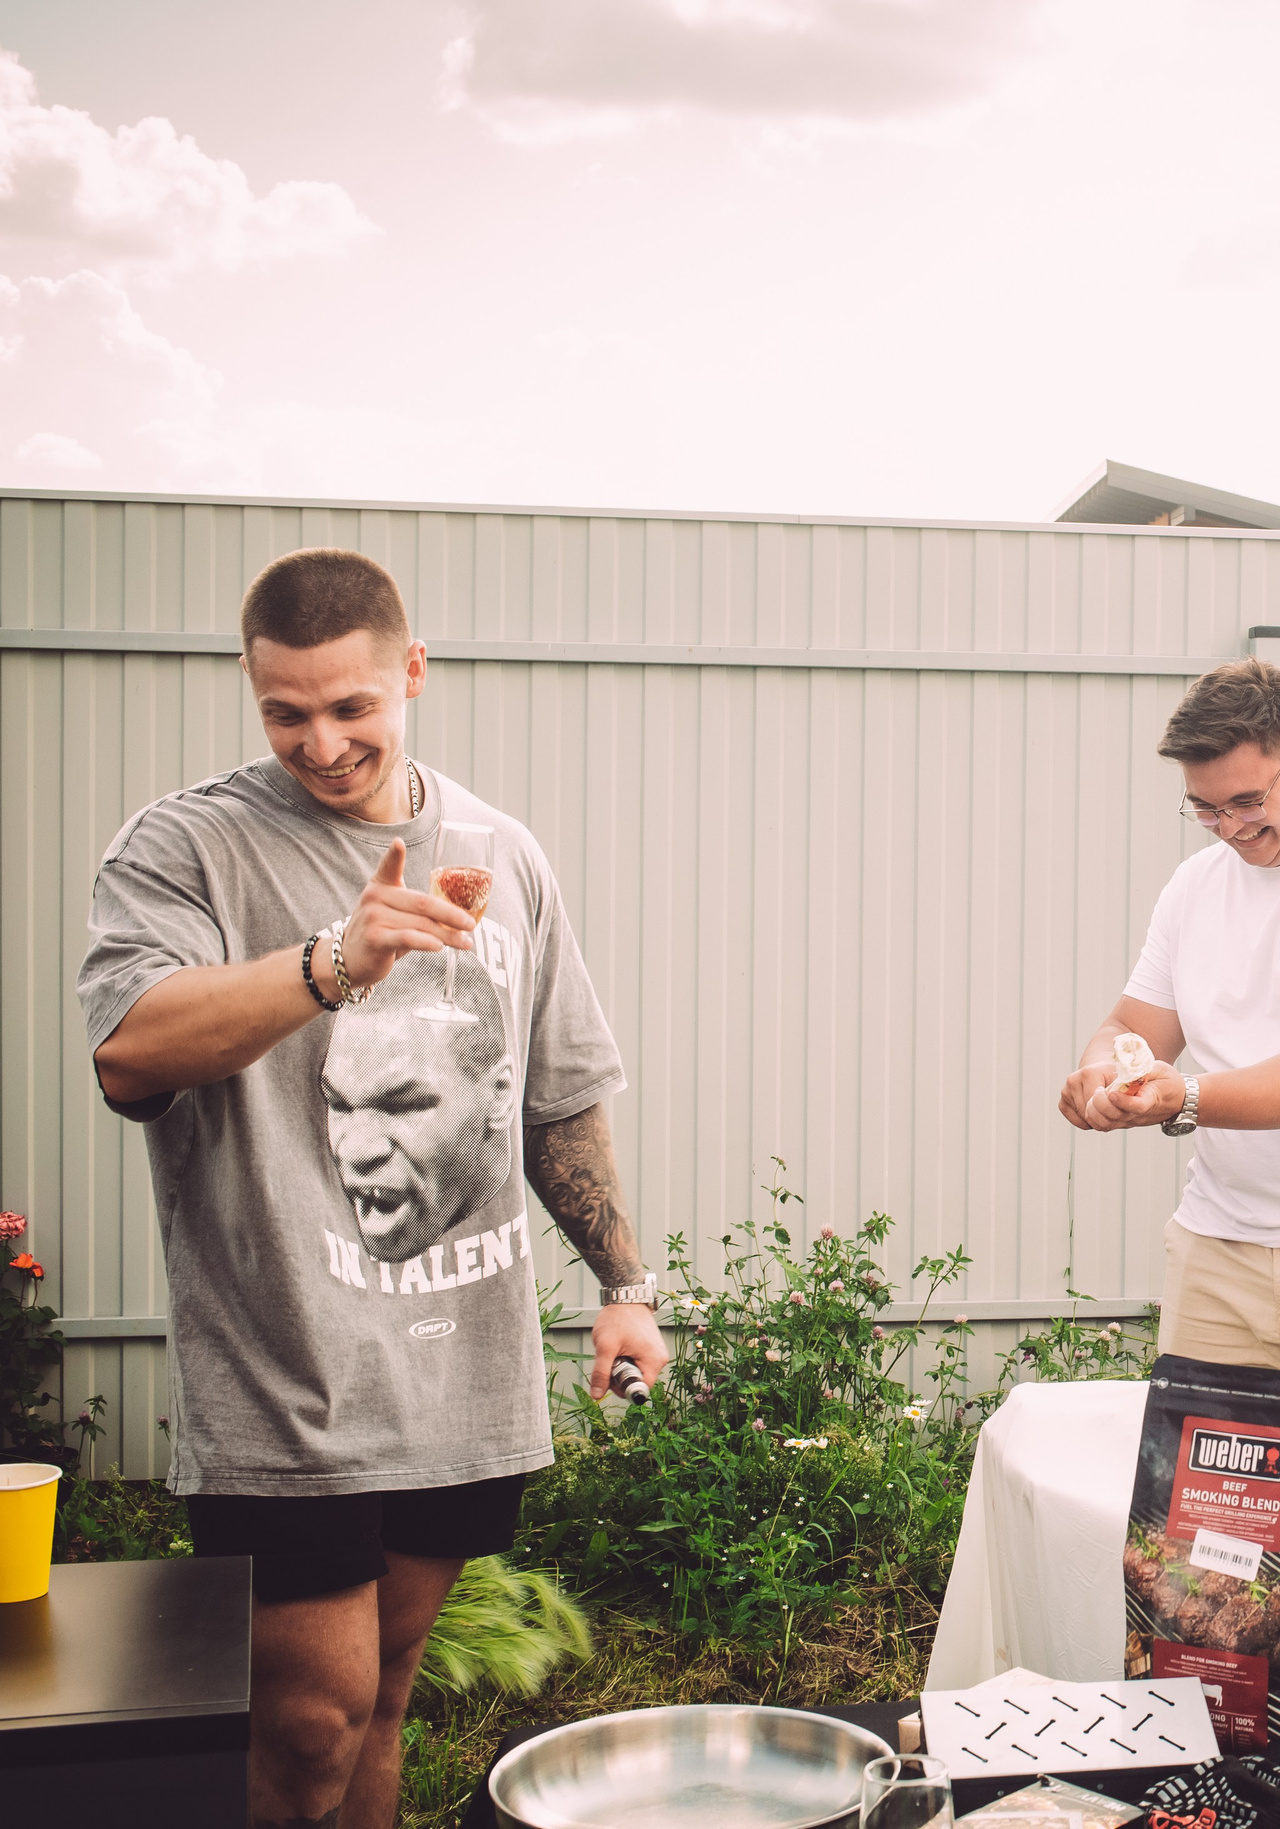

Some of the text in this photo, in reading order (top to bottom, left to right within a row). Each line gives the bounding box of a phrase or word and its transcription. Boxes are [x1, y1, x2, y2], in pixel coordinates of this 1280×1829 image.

[324, 1228, 367, 1290] IN
[1198, 1435, 1265, 1473] weber
[1222, 1480, 1248, 1493] BEEF
[1181, 1487, 1280, 1512] SMOKING BLEND
[1203, 1507, 1224, 1515] PERFECT
[1224, 1510, 1246, 1518] GRILLING
[1246, 1512, 1272, 1521] EXPERIENCE
[1234, 1725, 1254, 1733] NATURAL
[1235, 1717, 1255, 1727] 100%
